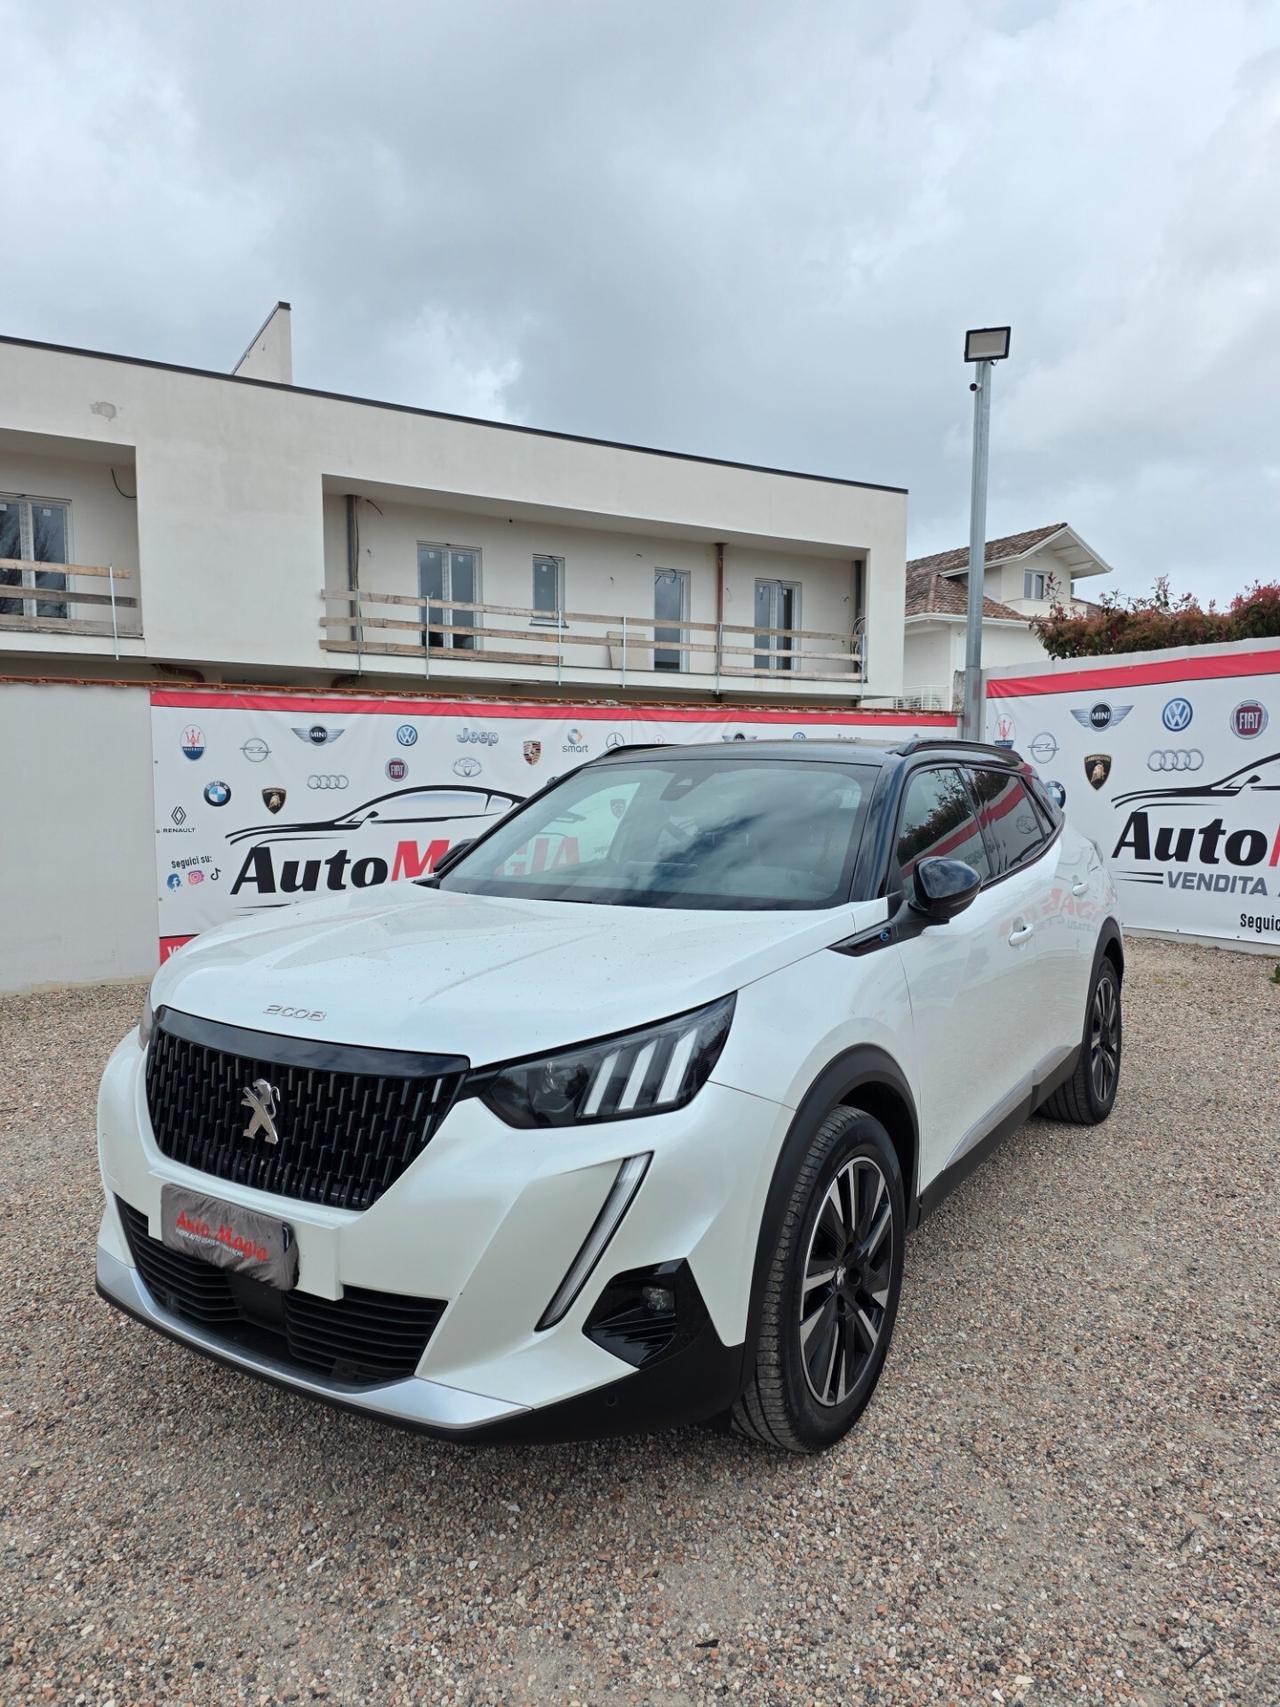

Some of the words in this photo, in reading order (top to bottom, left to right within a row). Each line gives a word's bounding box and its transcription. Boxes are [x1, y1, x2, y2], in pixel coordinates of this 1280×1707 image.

[1091, 711, 1111, 720] MINI
[1238, 711, 1261, 730] FIAT
[457, 727, 500, 746] Jeep
[562, 743, 589, 753] smart
[162, 827, 196, 836] RENAULT
[1111, 811, 1280, 867] Auto
[1167, 870, 1268, 897] VENDITA
[263, 1004, 328, 1022] 2008
[217, 1223, 270, 1262] Magia
